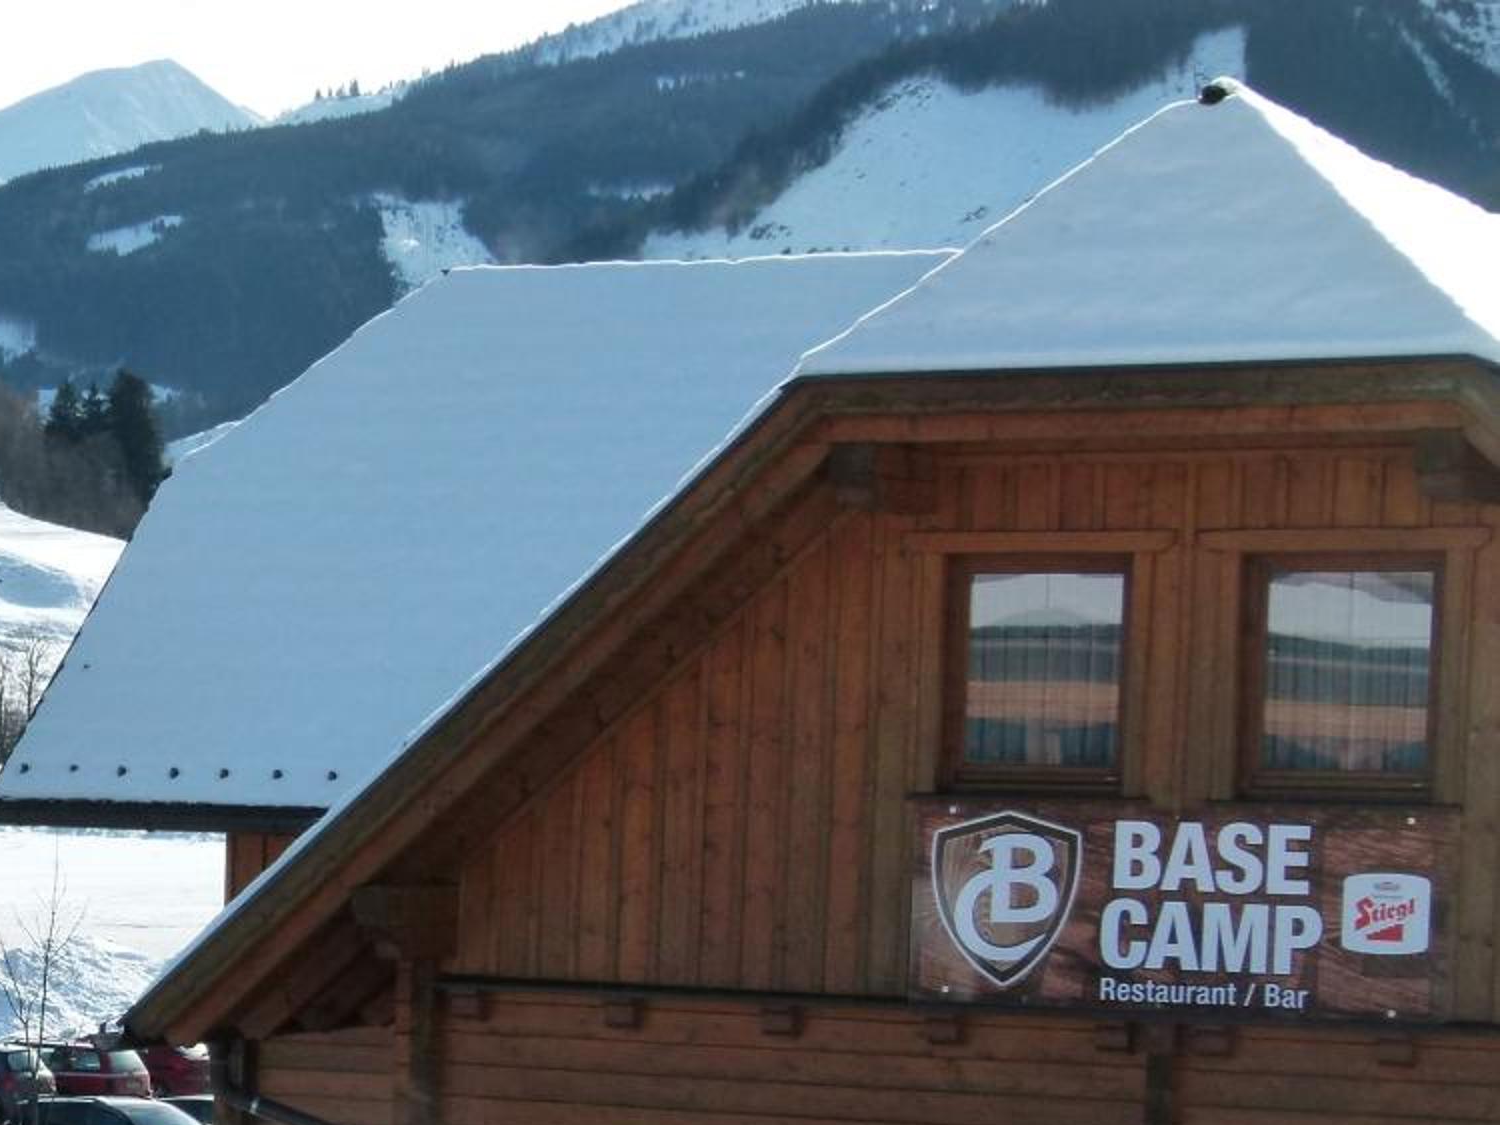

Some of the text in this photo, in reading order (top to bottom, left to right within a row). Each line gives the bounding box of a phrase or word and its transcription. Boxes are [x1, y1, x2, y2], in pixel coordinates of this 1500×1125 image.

[1113, 820, 1311, 895] BASE
[1101, 898, 1323, 974] CAMP
[1101, 978, 1236, 1006] Restaurant
[1265, 984, 1309, 1009] Bar
